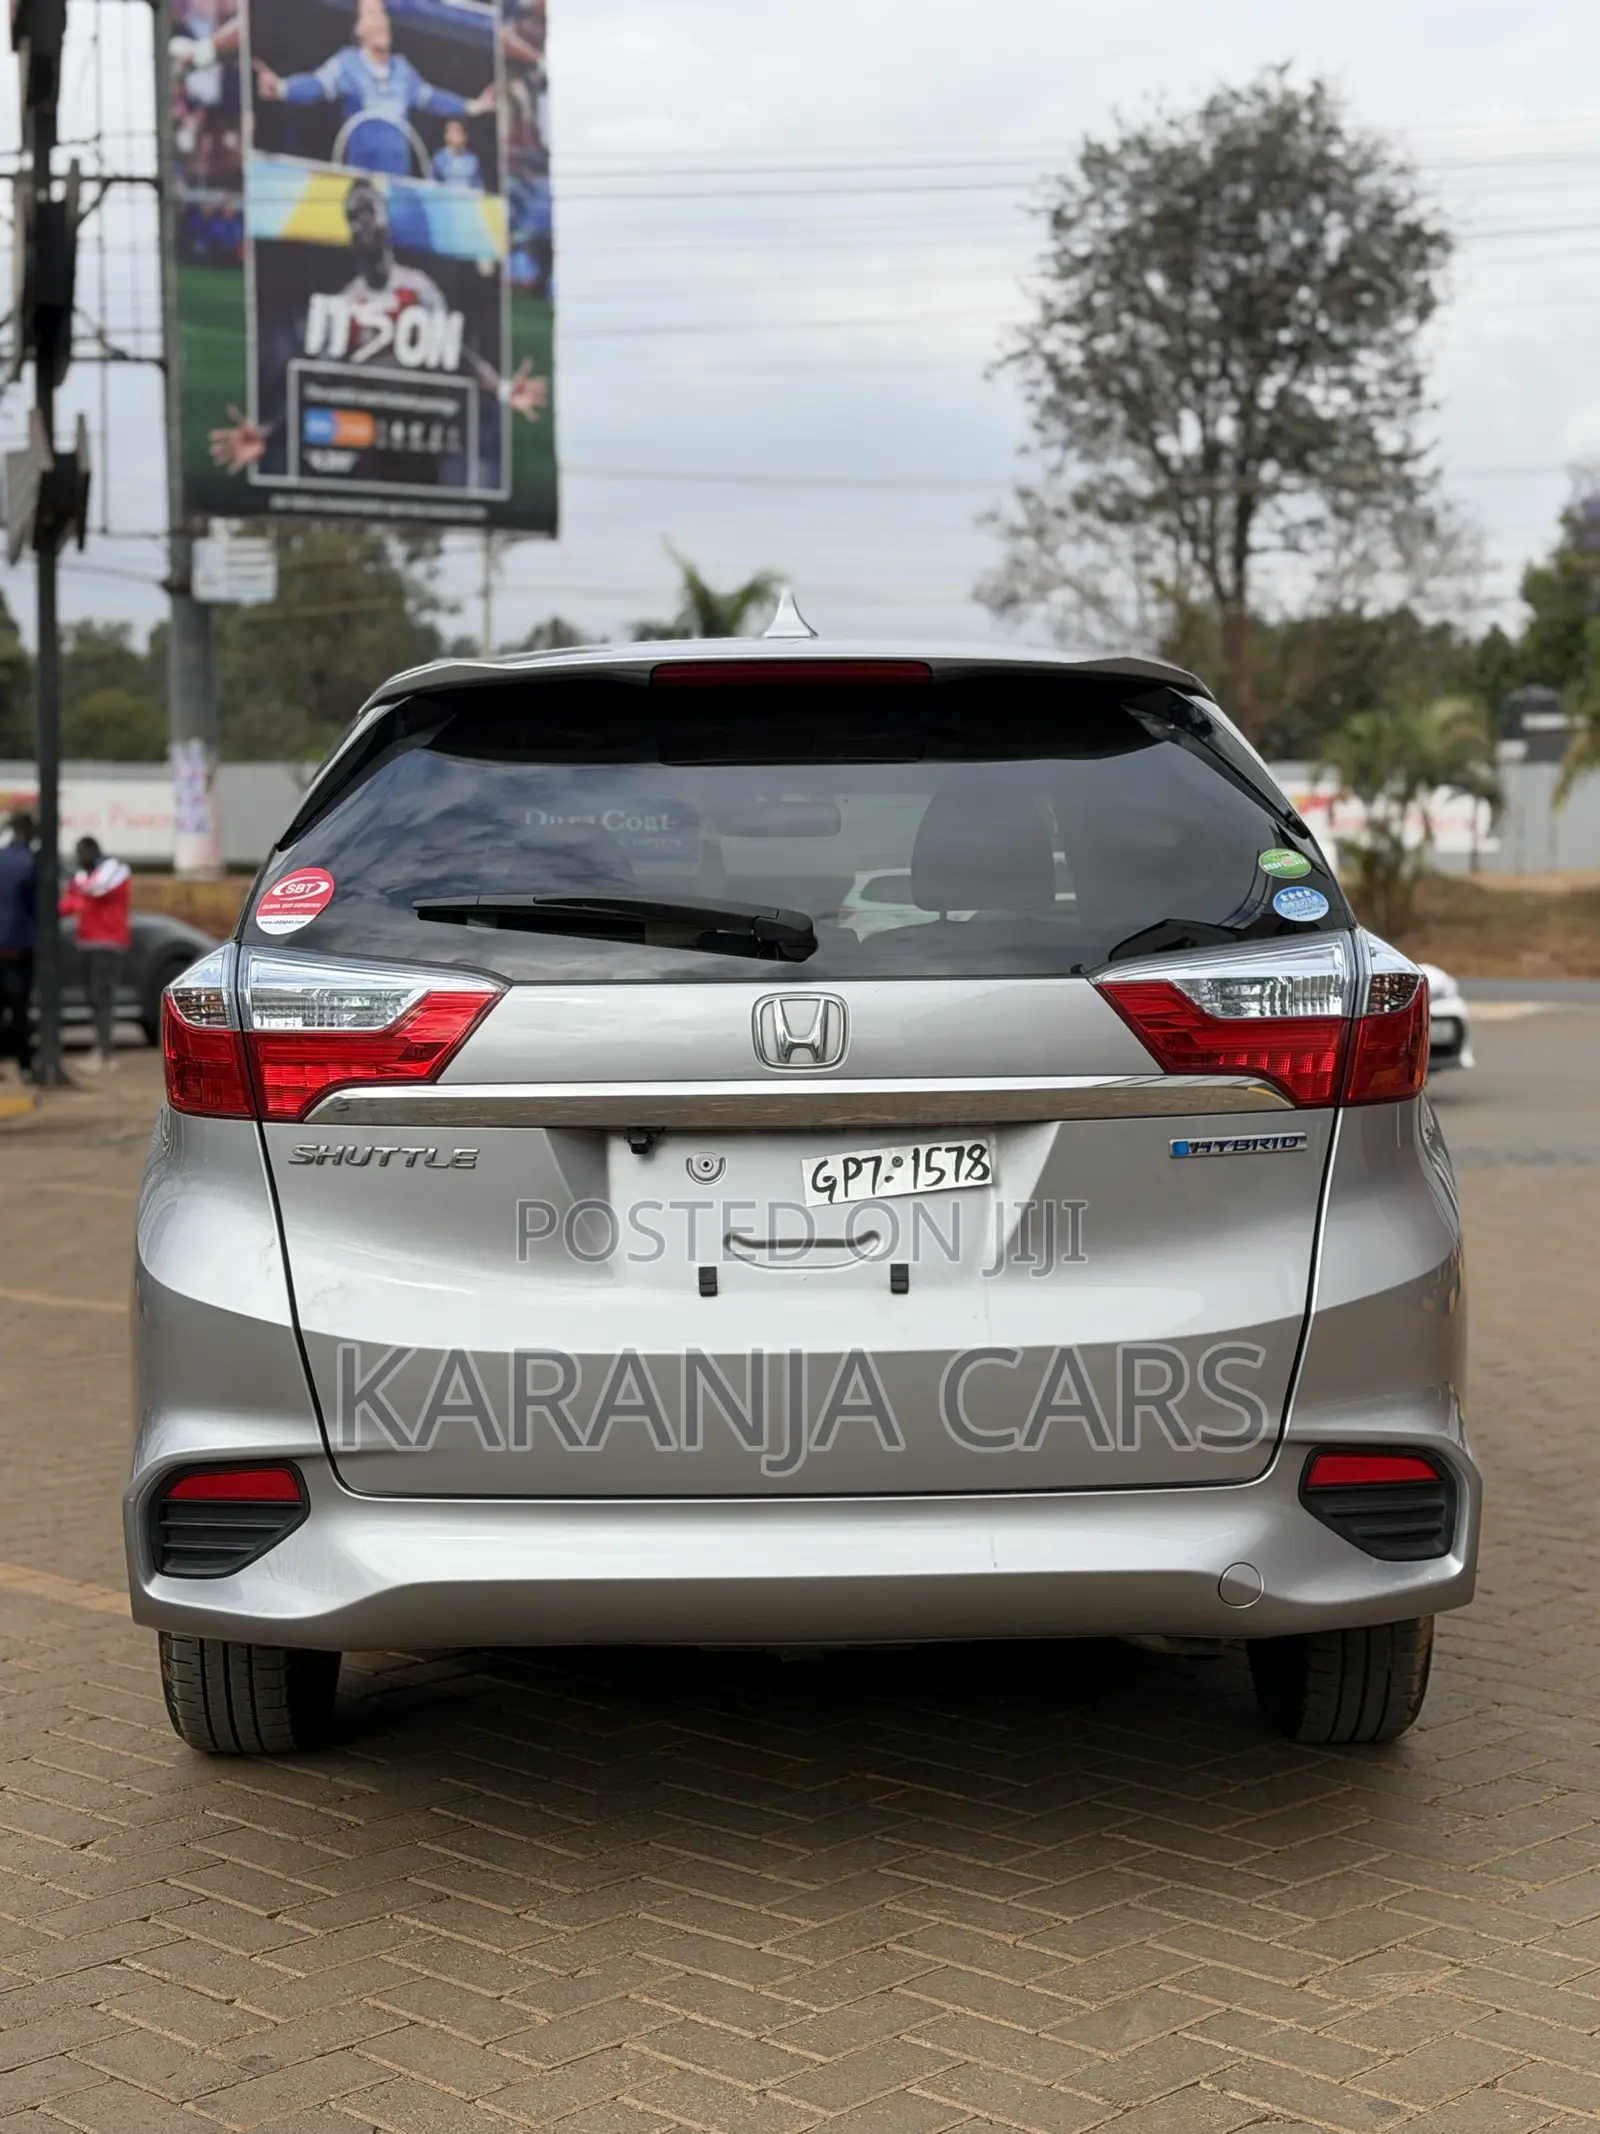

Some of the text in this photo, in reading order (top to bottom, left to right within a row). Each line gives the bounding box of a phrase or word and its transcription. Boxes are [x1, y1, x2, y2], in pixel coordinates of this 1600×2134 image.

[601, 809, 674, 833] Coat
[285, 883, 317, 894] SBT
[1189, 1136, 1301, 1154] HYBRID
[288, 1144, 480, 1169] SHUTTLE
